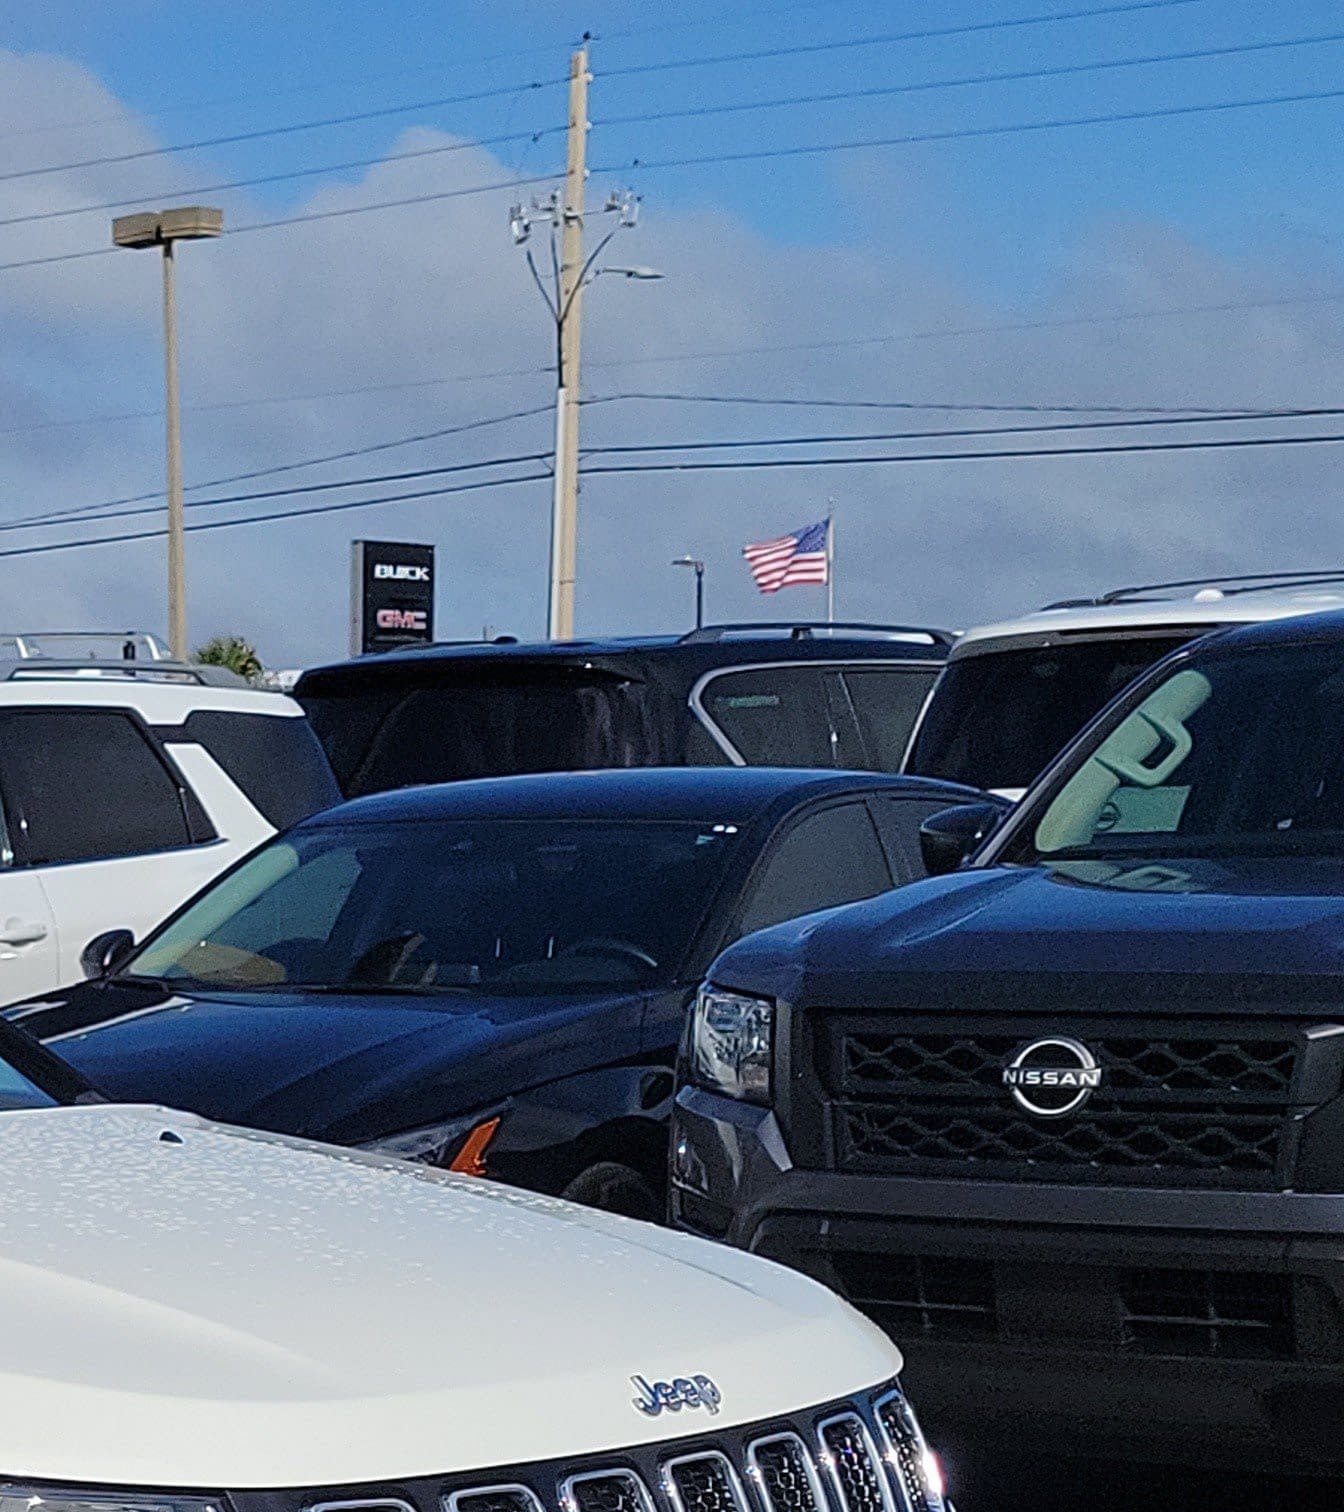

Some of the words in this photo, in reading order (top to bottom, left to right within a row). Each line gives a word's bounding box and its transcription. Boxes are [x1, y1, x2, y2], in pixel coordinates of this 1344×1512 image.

[374, 564, 430, 580] BUICK
[376, 609, 427, 630] GMC
[1002, 1069, 1098, 1086] NISSAN
[630, 1374, 721, 1416] Jeep
